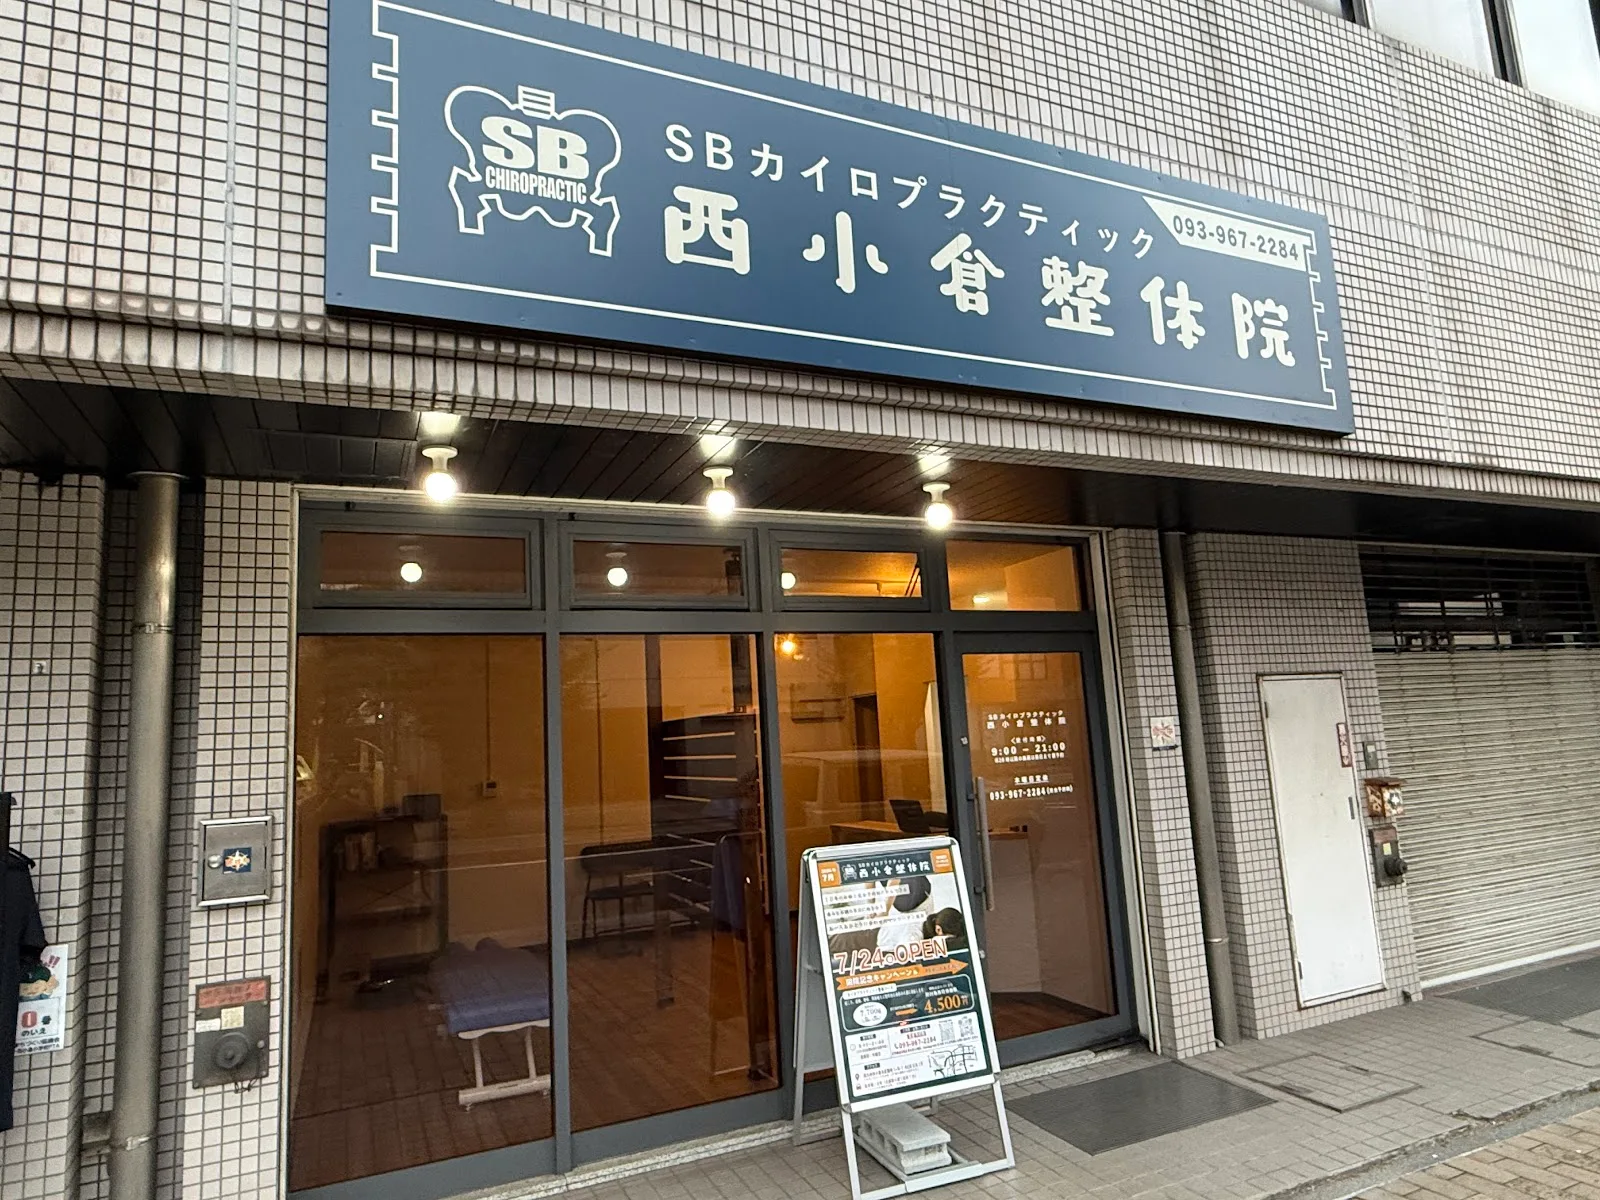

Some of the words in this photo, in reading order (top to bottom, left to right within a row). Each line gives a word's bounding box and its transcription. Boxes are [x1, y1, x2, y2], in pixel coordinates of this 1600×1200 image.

[481, 116, 589, 180] SB
[484, 164, 588, 205] CHIROPRACTIC
[664, 123, 1155, 259] SBカイロプラクティック
[1172, 214, 1300, 262] 093-967-2284
[663, 185, 1296, 368] 西小倉整体院
[991, 745, 1017, 757] 9:00
[1034, 742, 1066, 753] 21:00
